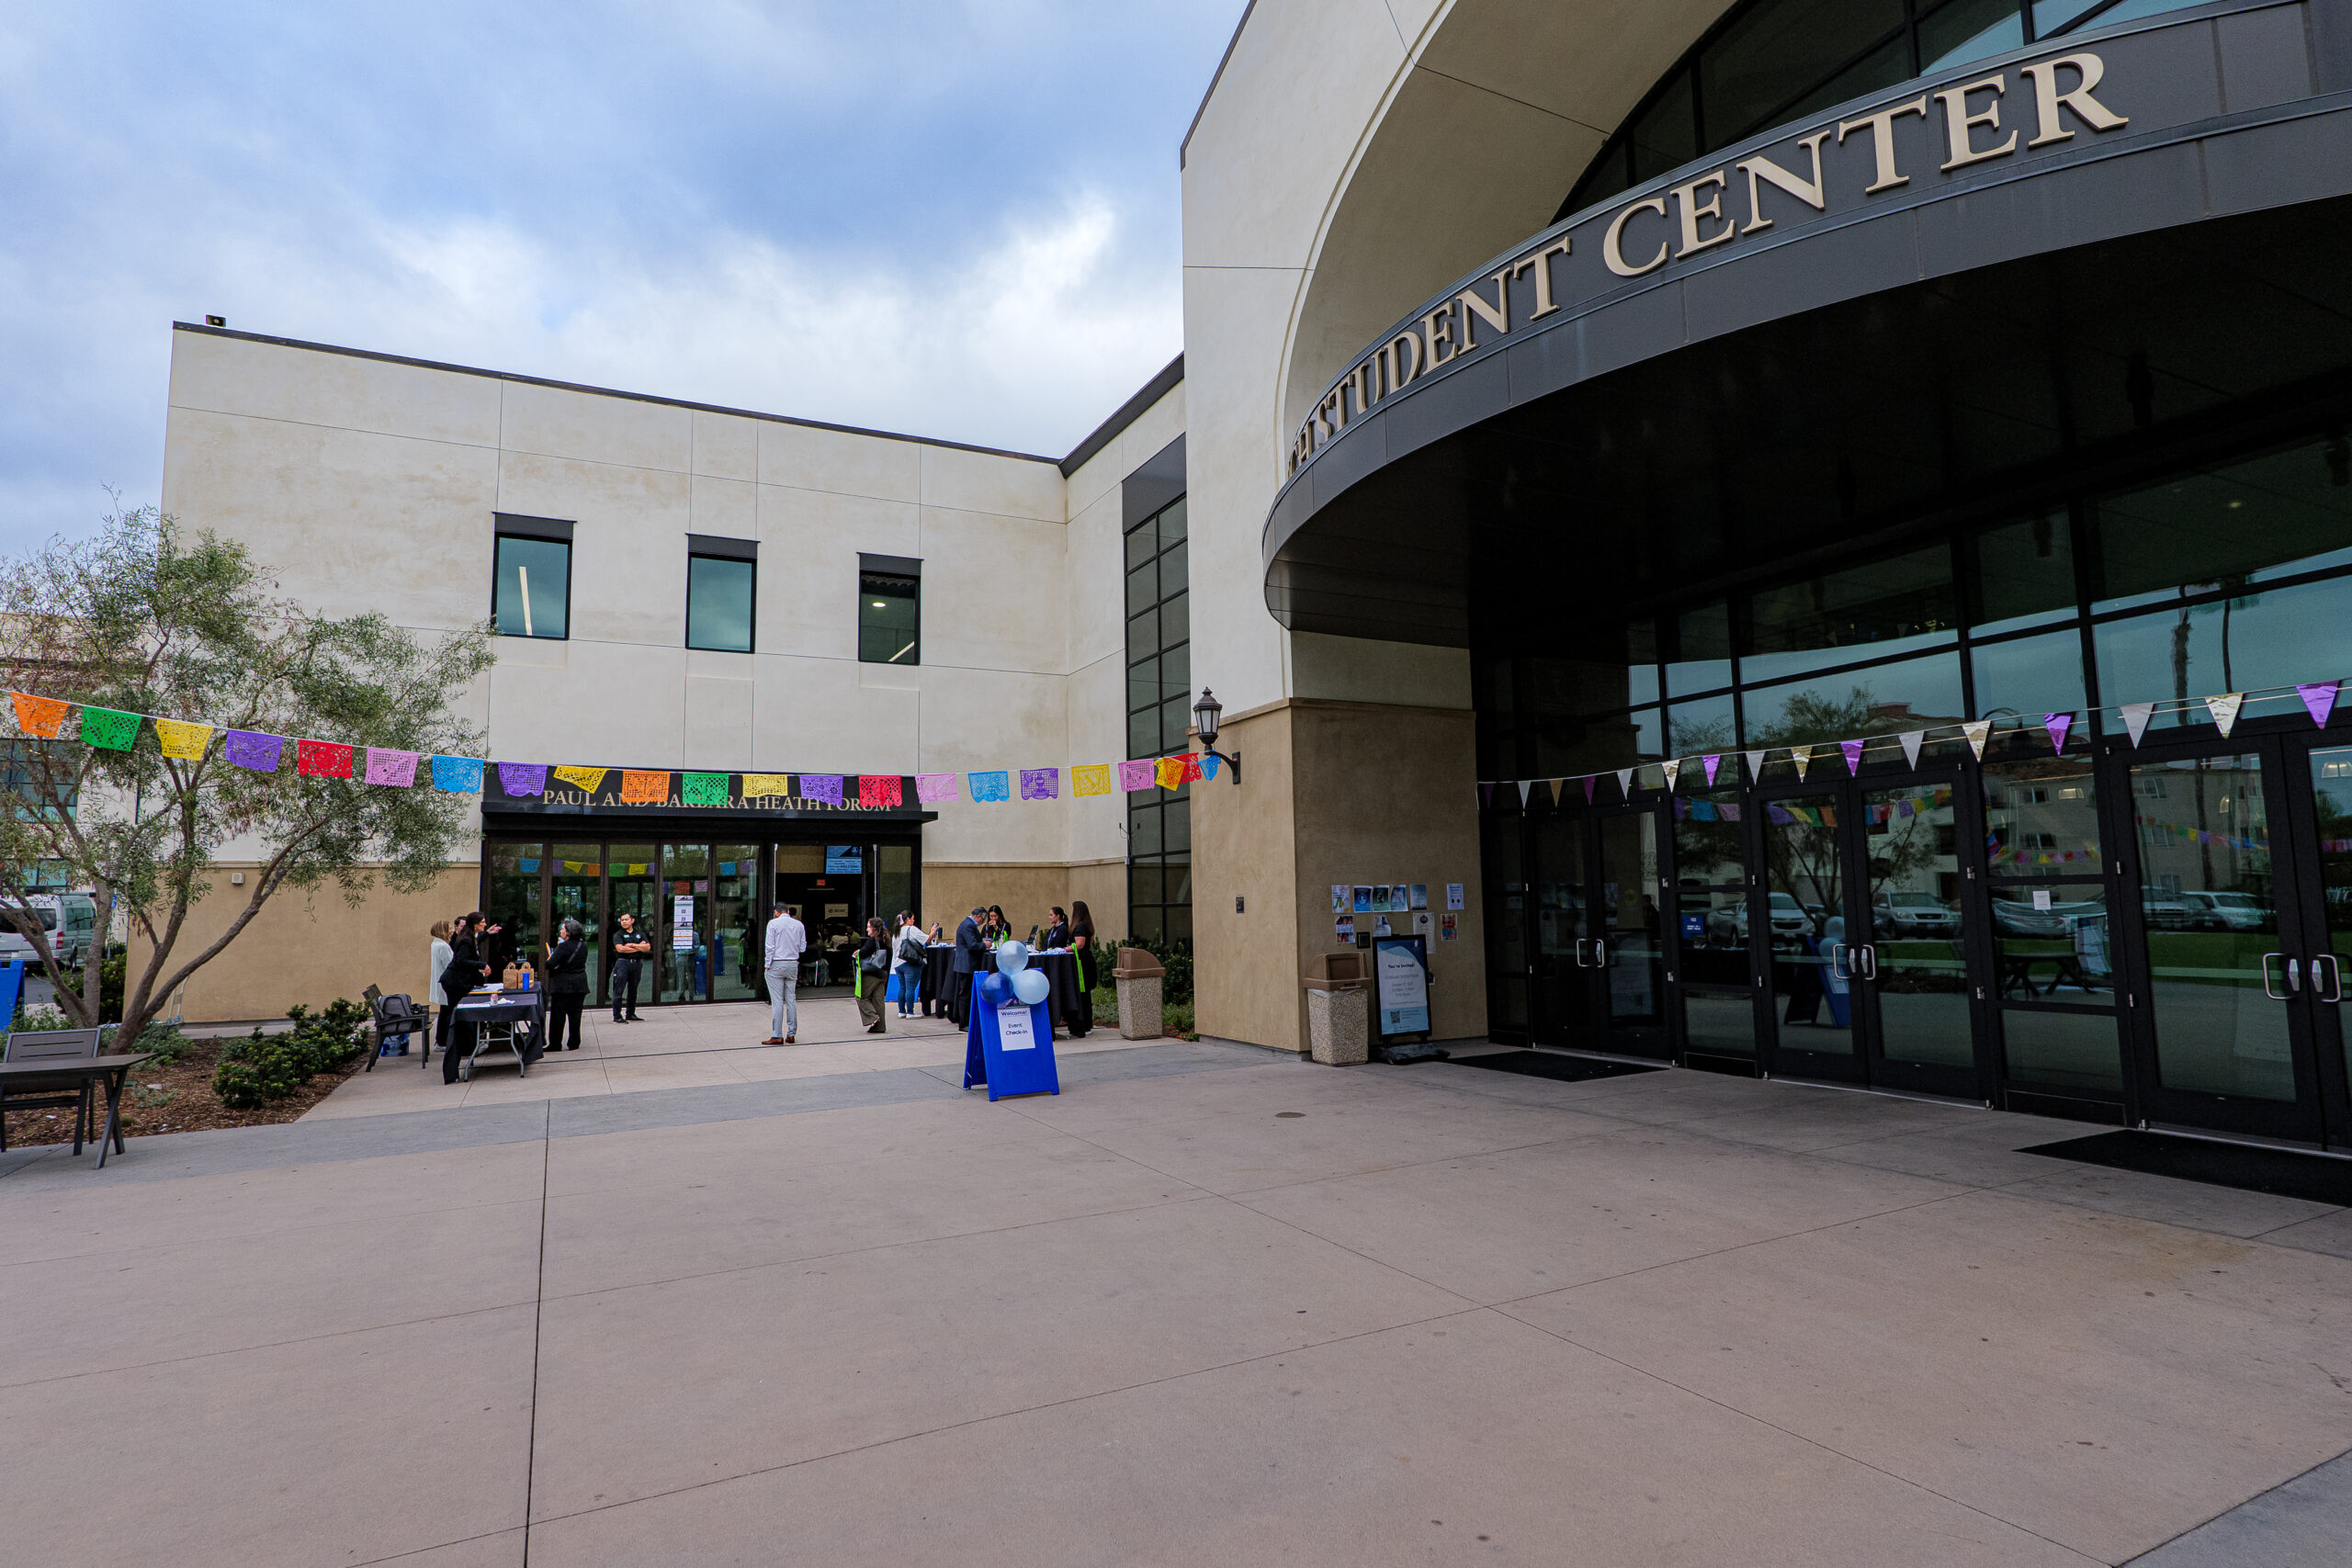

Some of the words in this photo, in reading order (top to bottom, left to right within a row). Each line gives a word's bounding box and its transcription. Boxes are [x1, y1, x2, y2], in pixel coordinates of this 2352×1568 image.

[1317, 235, 1572, 449] STUDENT
[1602, 52, 2130, 276] CENTER
[542, 790, 596, 806] PAUL
[755, 796, 825, 810] HEATH
